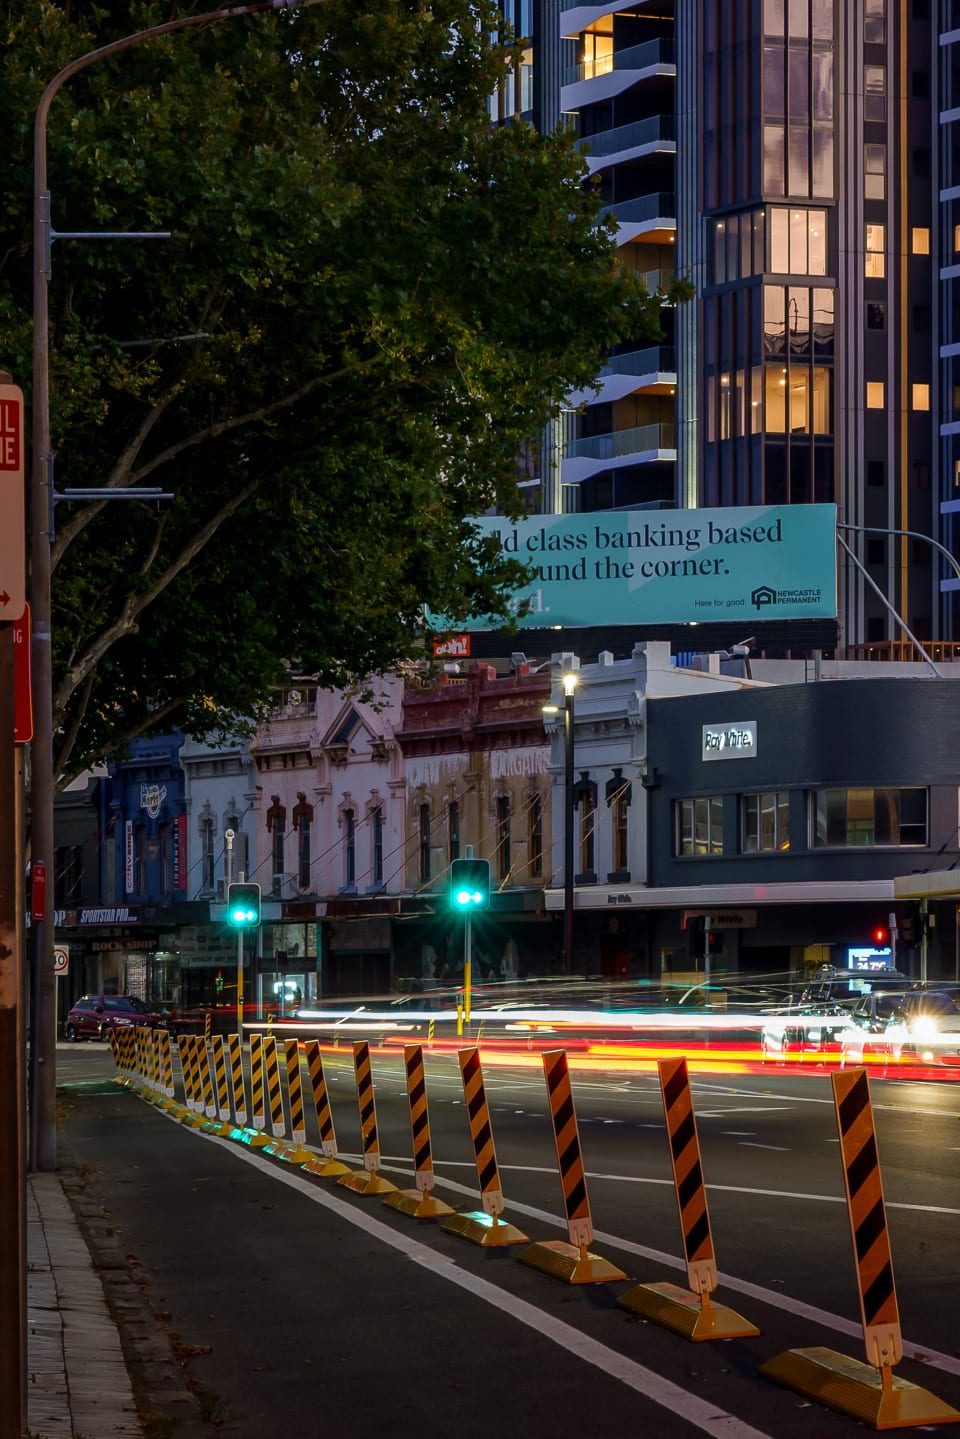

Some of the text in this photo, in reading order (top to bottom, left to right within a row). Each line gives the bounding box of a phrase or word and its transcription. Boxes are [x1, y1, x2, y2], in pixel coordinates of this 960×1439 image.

[526, 528, 588, 552] class
[594, 524, 701, 551] banking
[707, 519, 783, 545] based
[594, 556, 635, 579] the
[641, 557, 730, 578] corner.
[777, 588, 822, 597] NEWCASTLE
[694, 598, 745, 609] Here for good
[777, 596, 822, 604] PERMANENT
[705, 732, 722, 750] Ray
[80, 908, 116, 923] SPORTSTAR
[91, 939, 157, 952] ROCK SHOP
